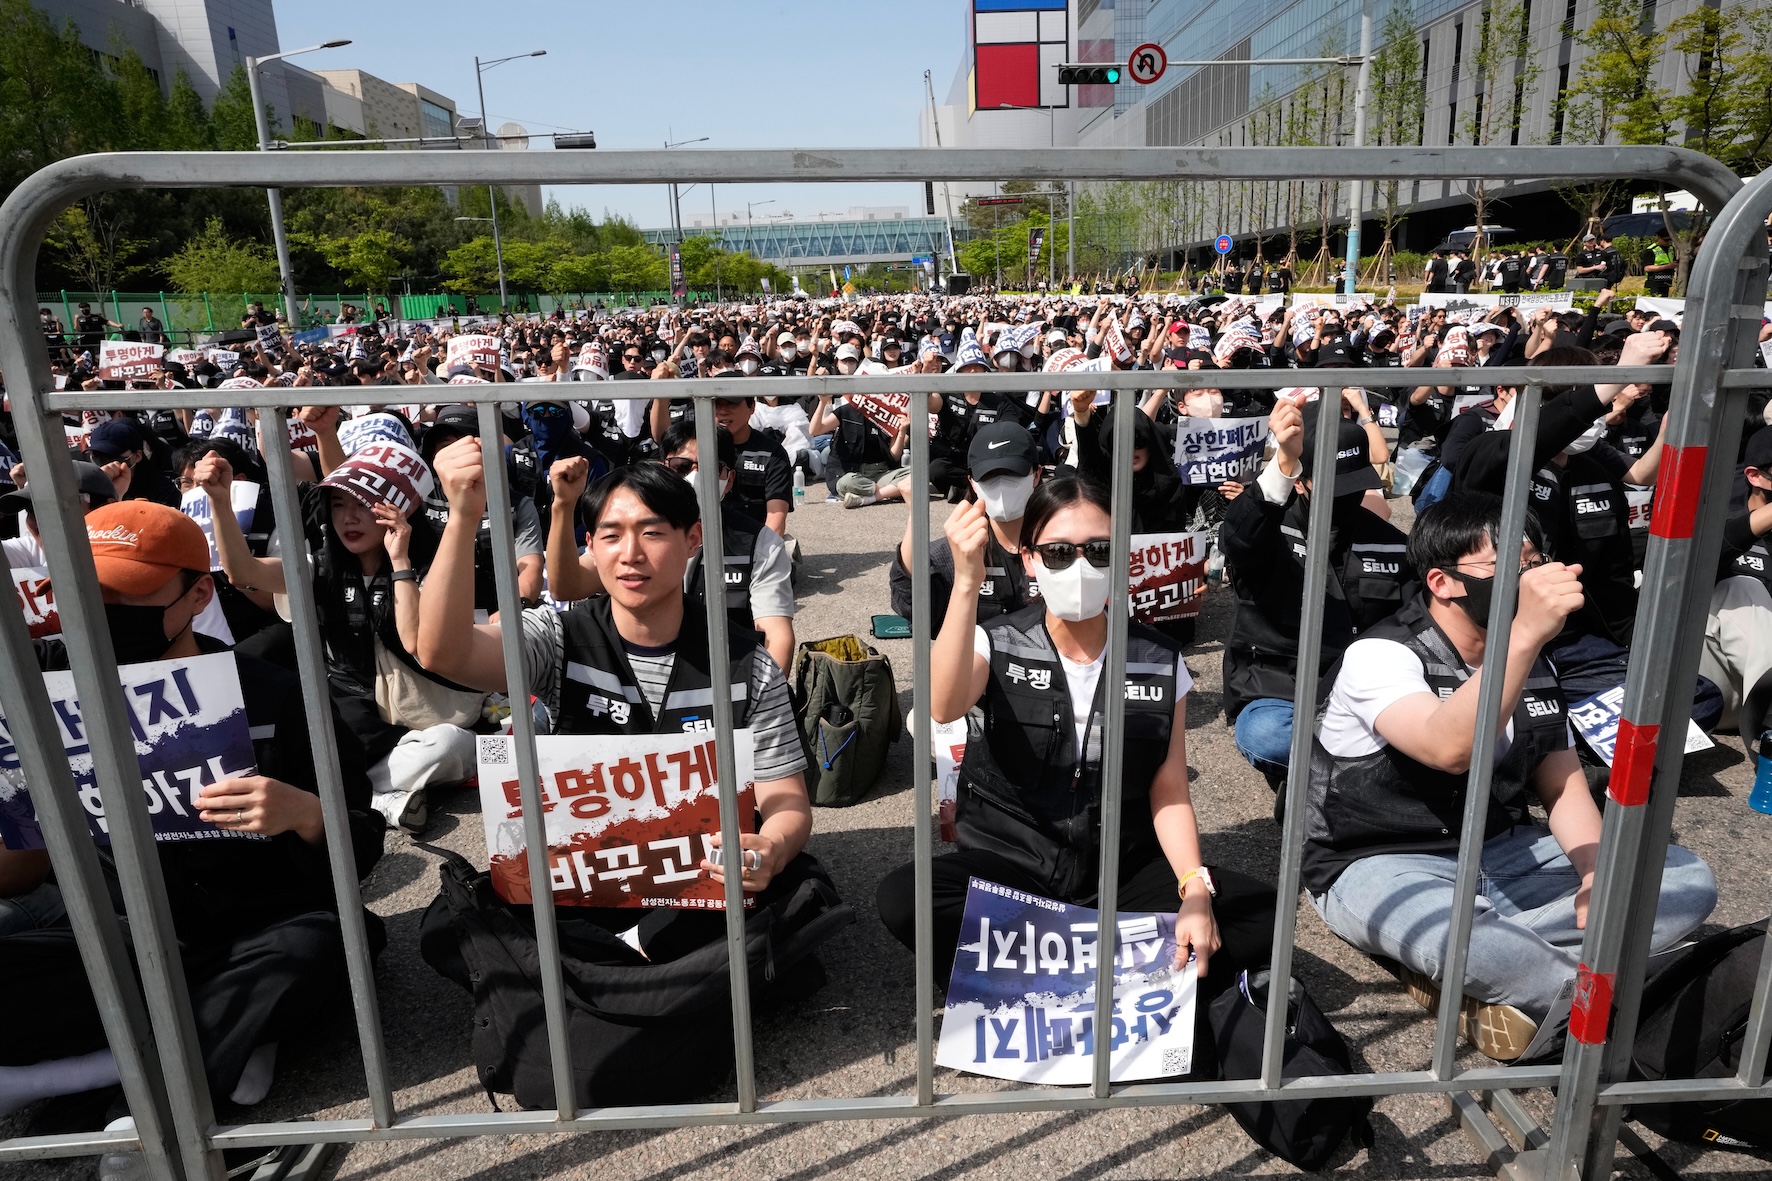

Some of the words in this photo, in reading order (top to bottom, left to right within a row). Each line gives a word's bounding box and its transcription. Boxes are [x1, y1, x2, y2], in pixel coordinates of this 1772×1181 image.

[1499, 295, 1520, 306] NSEU
[1109, 325, 1125, 355] 명하게
[105, 346, 155, 361] 투명하게
[1048, 349, 1075, 372] 명하게
[1183, 420, 1260, 453] 상한폐지
[1336, 446, 1361, 460] SEU
[360, 446, 427, 482] 하게
[743, 460, 765, 472] SELU
[1188, 452, 1263, 484] 실현하자
[1576, 498, 1611, 514] SELU
[86, 525, 143, 543] nockin'
[1128, 535, 1194, 577] 명하게
[1362, 558, 1399, 574] SELU
[725, 573, 742, 583] LU
[979, 580, 994, 596] 쟁
[1005, 662, 1052, 690] 투쟁
[586, 693, 632, 725] 투쟁
[1527, 697, 1560, 718] SELU
[682, 717, 715, 734] SEL
[154, 830, 220, 841] 삼성전자노동조합
[972, 879, 1013, 898] 공동투쟁본부
[641, 898, 706, 907] 삼성전자노동조합
[1012, 891, 1066, 913] 삼성전자노동조합
[957, 916, 1166, 976] 실현하자
[973, 990, 1181, 1062] 상한폐지
